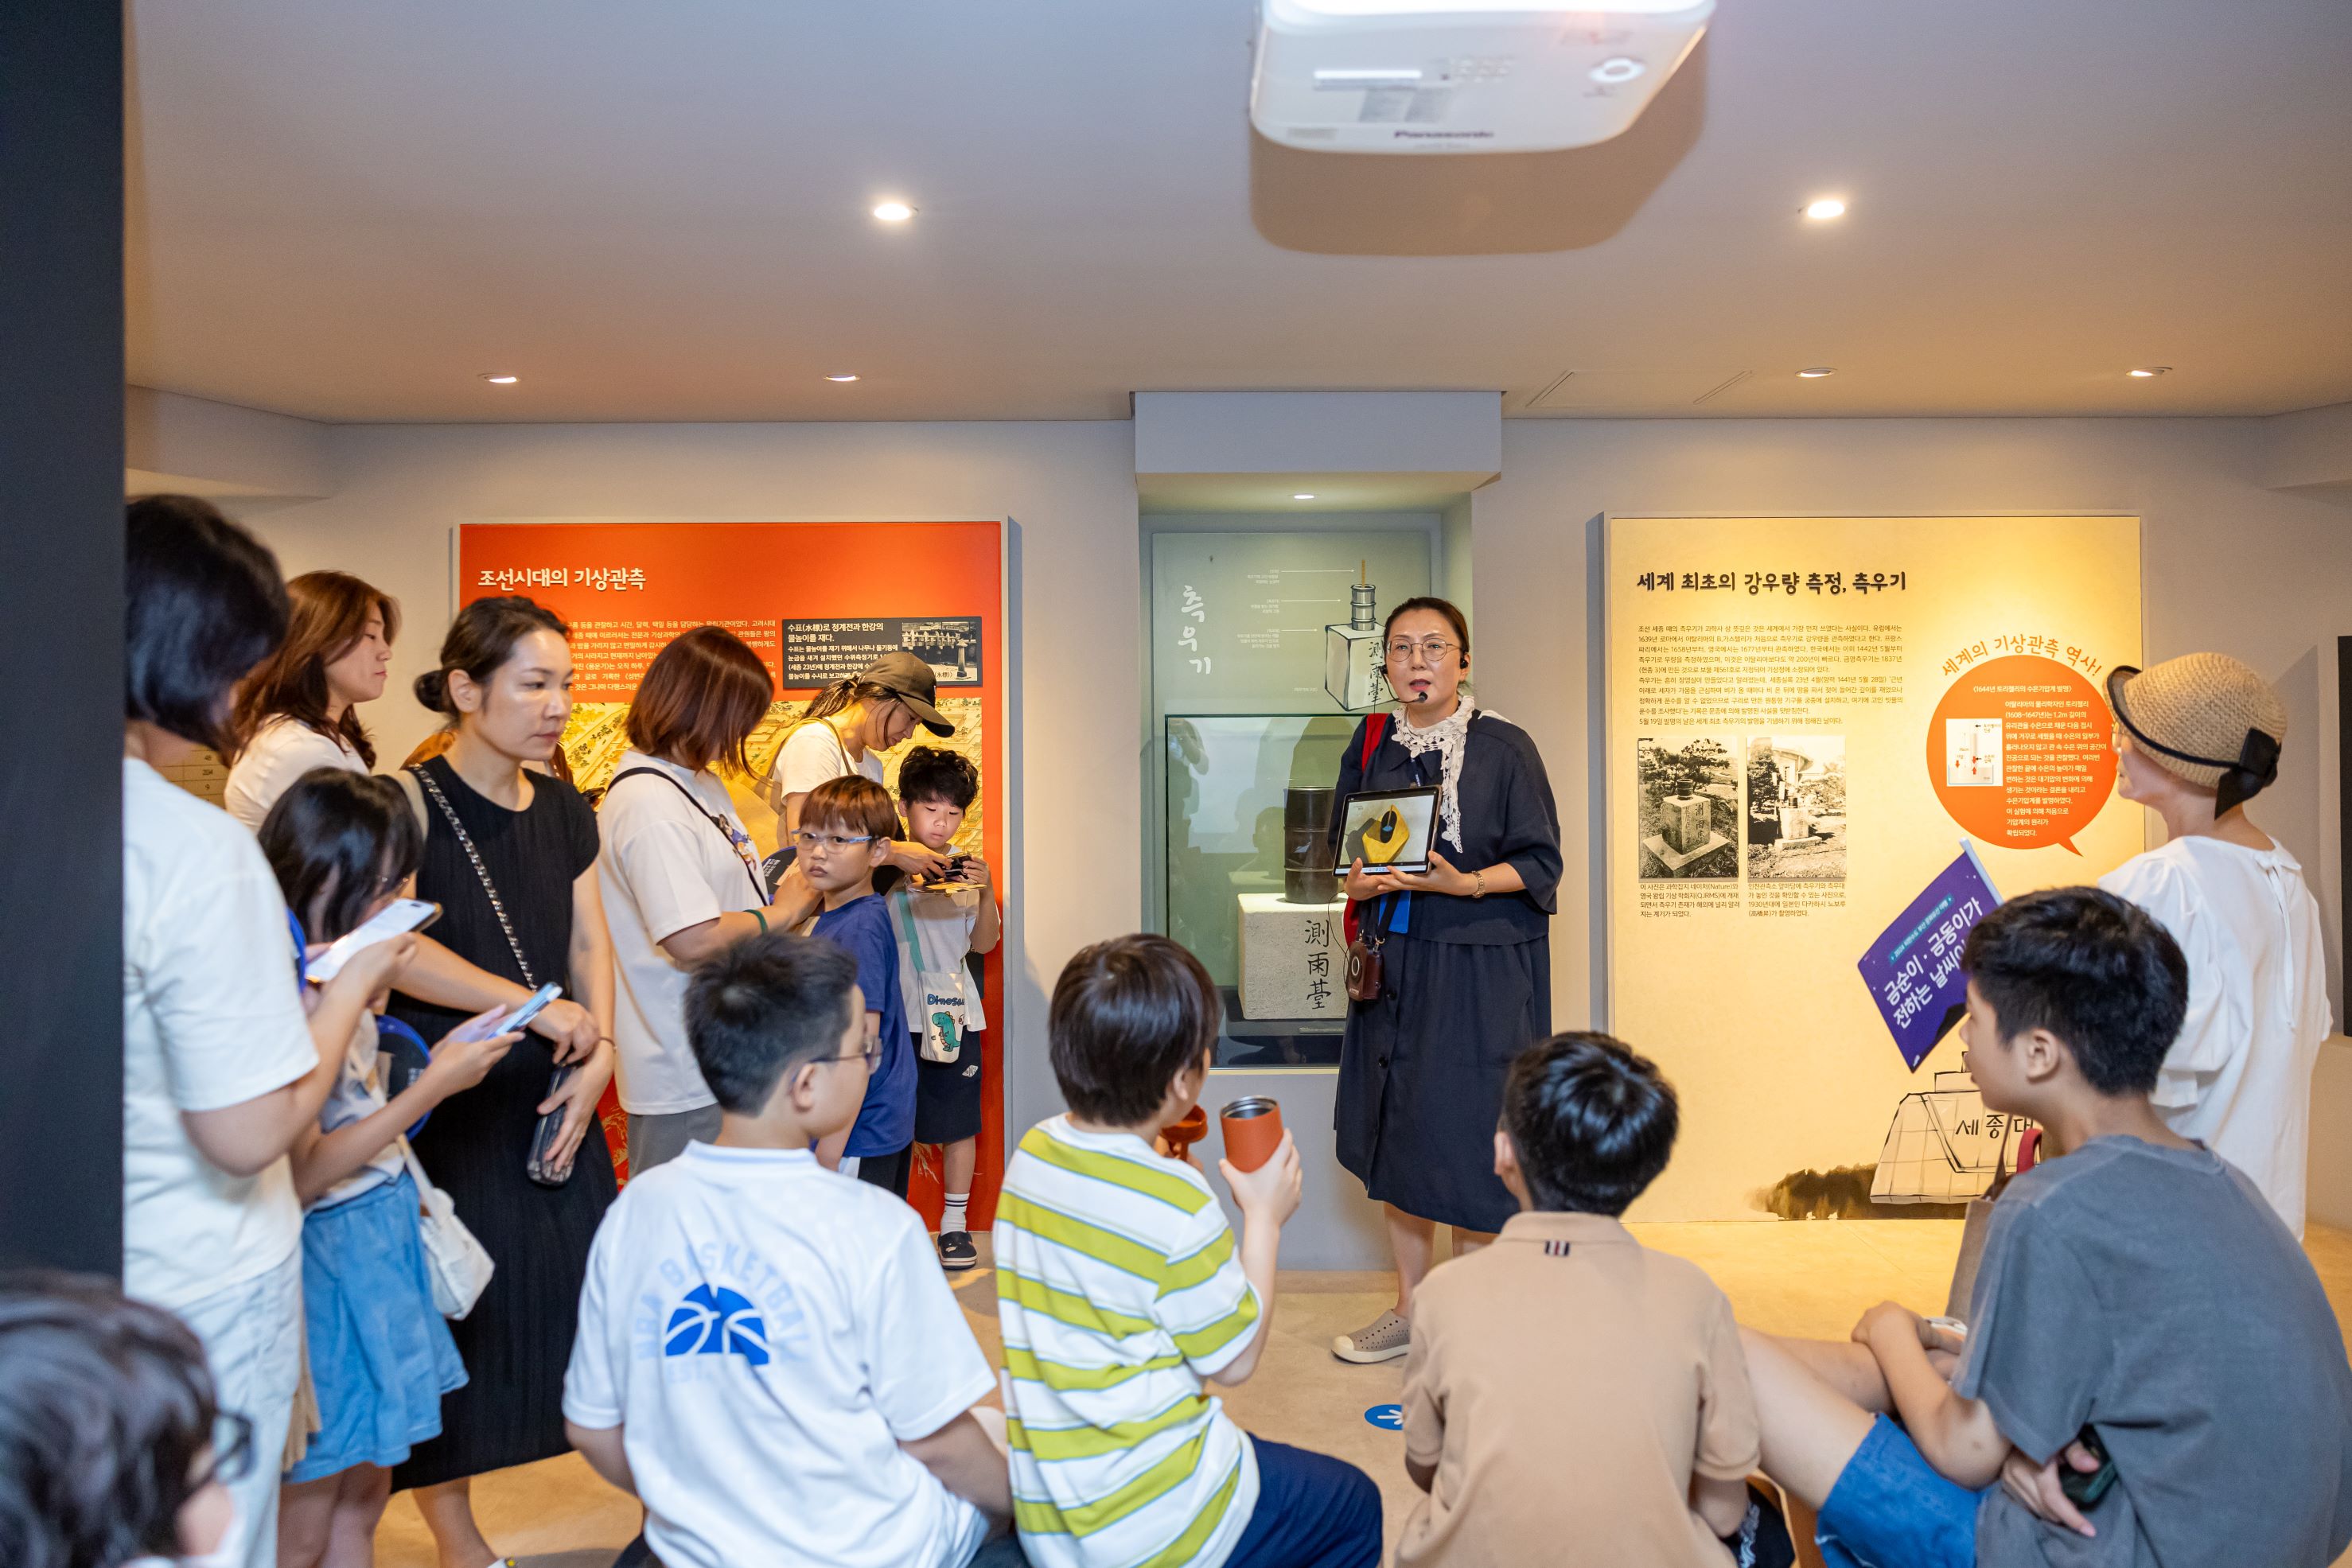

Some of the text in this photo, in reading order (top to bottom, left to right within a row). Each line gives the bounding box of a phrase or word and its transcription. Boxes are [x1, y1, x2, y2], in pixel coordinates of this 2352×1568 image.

[477, 567, 645, 590] 조선시대의 기상관측
[1637, 571, 1905, 594] 세계 최초의 강우량 측정, 측우기
[788, 633, 816, 642] 물높이를
[862, 622, 883, 631] 한강의
[1178, 584, 1211, 675] 측우기
[1941, 634, 2102, 677] 세계의 기상관측 역사!
[1885, 954, 1924, 1006] 금순이
[1928, 897, 1983, 957] 금동이가
[1894, 983, 1932, 1029] 전하는
